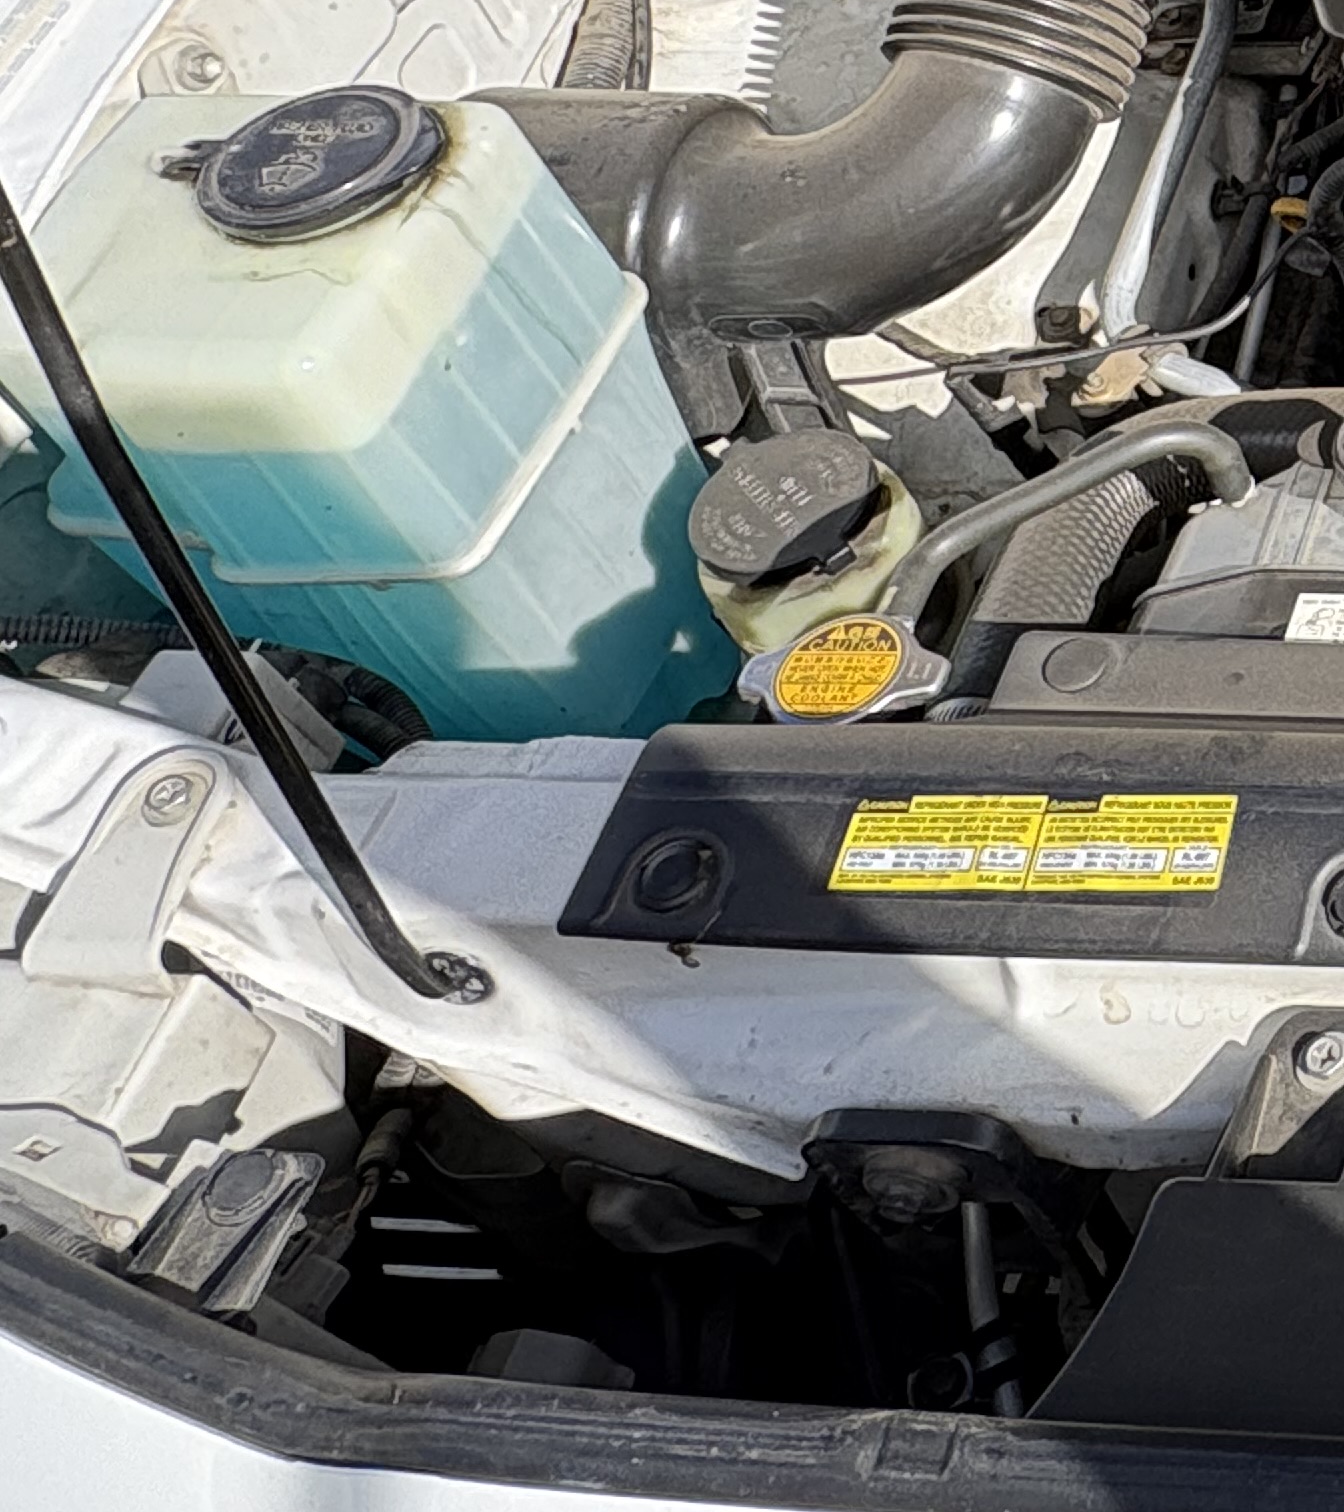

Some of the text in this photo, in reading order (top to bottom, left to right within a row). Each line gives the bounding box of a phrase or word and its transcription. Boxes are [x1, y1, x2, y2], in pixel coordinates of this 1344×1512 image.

[809, 639, 891, 651] CAUTION
[801, 684, 856, 692] ENGINE
[790, 694, 858, 703] COOLANT
